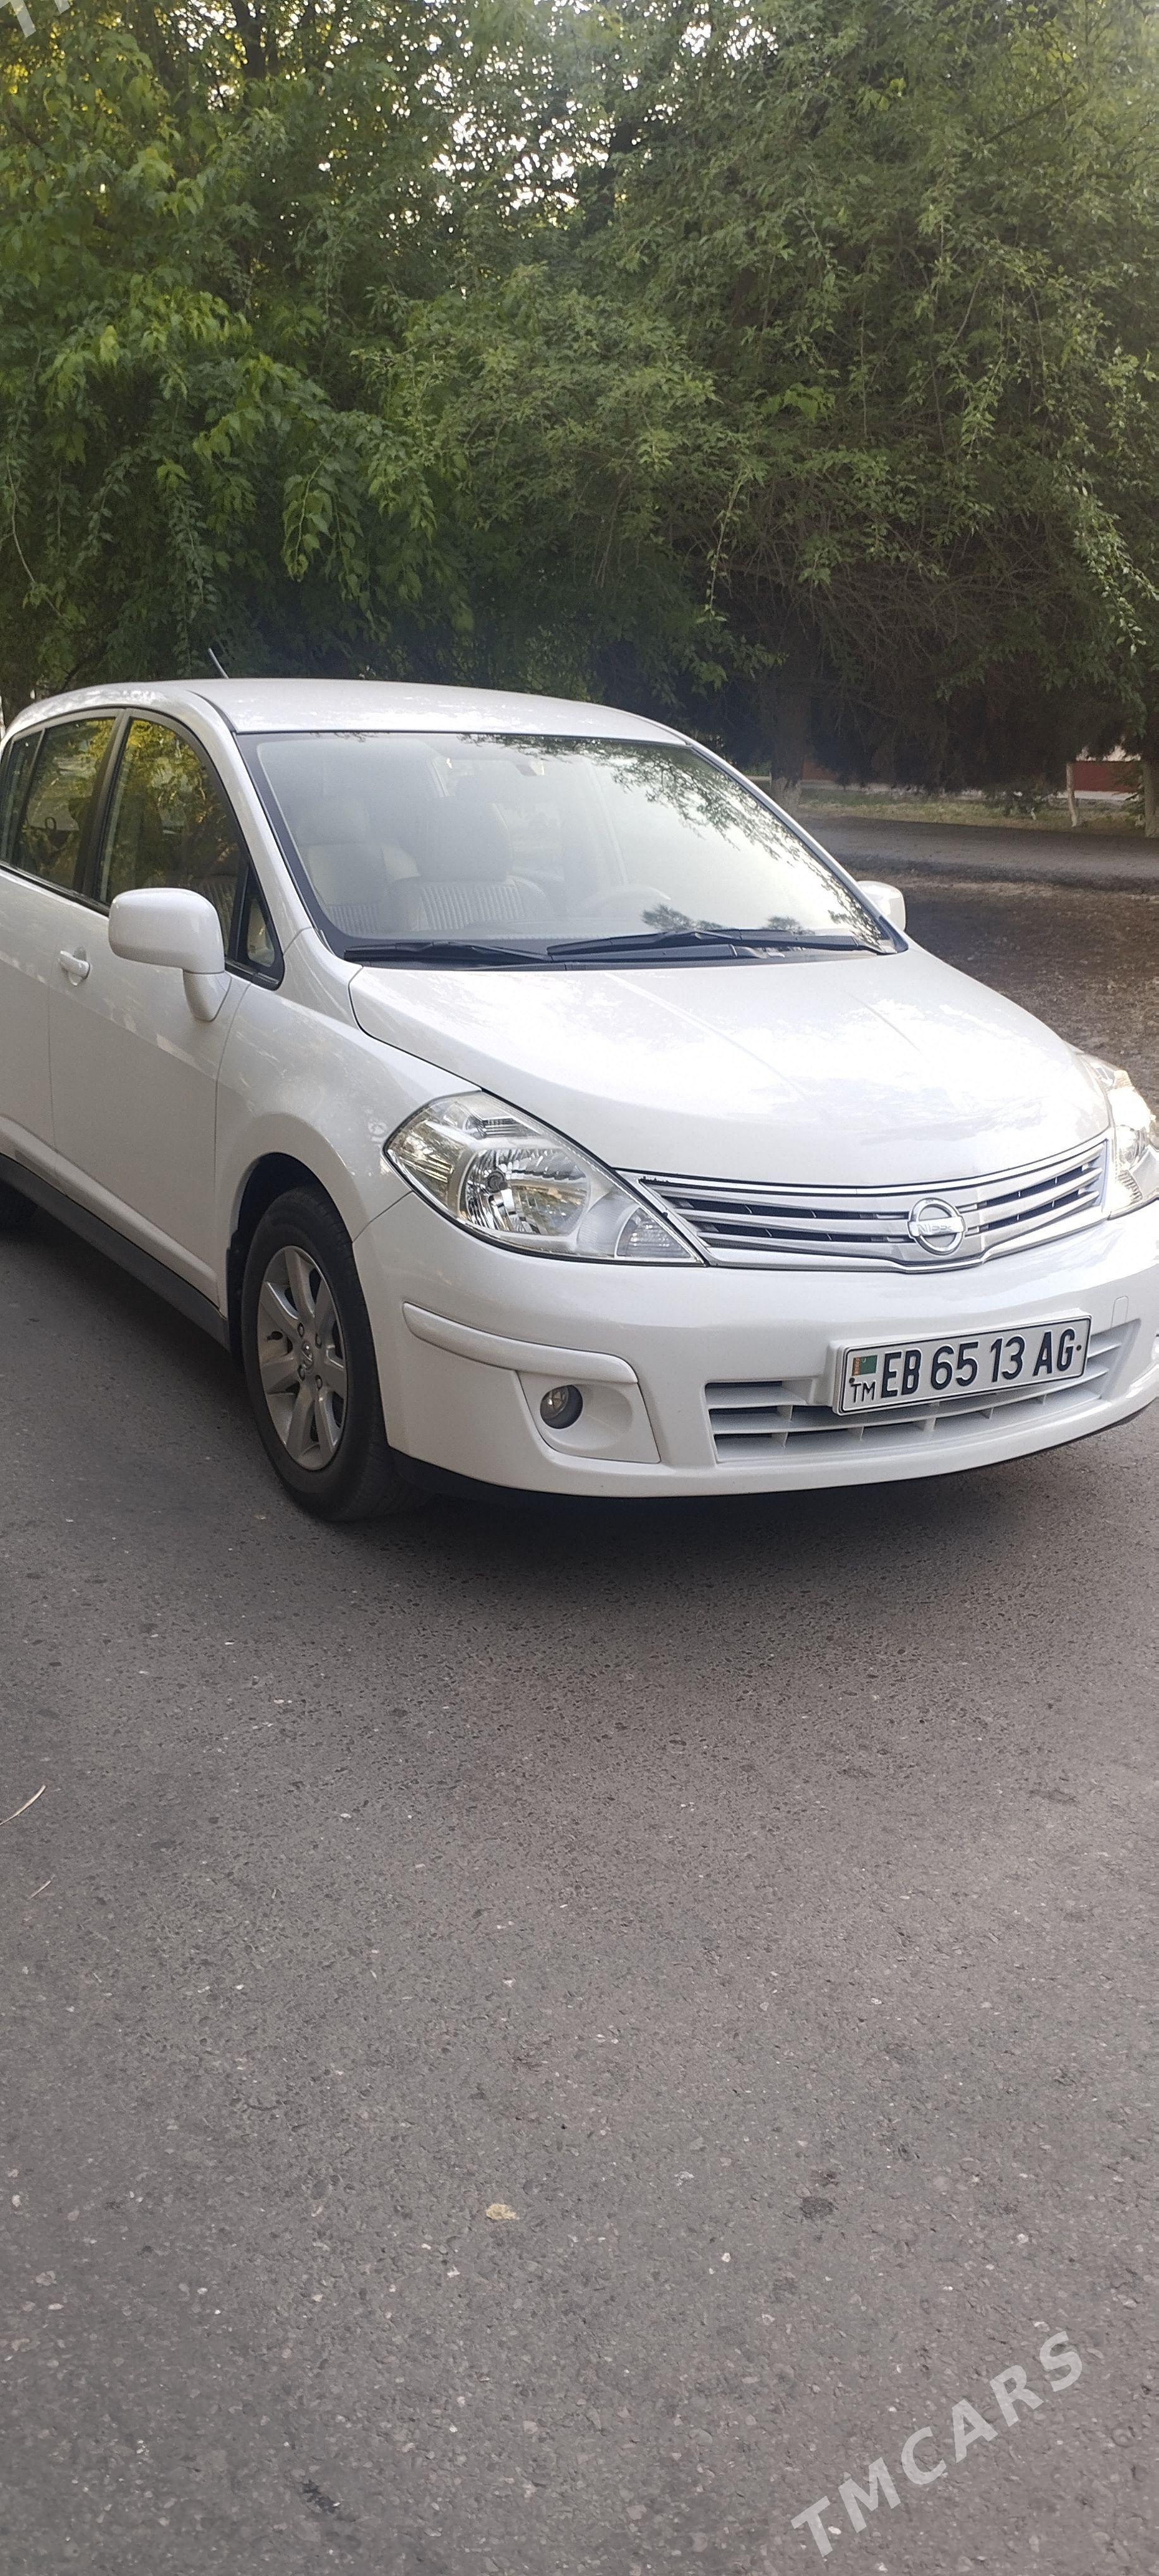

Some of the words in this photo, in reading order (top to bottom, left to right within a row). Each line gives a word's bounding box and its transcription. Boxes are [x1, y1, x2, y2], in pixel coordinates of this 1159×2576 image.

[881, 1349, 922, 1398] EB
[930, 1342, 979, 1390] 65
[989, 1335, 1026, 1383] 13
[1031, 1328, 1075, 1376] AG
[851, 1381, 876, 1403] TM
